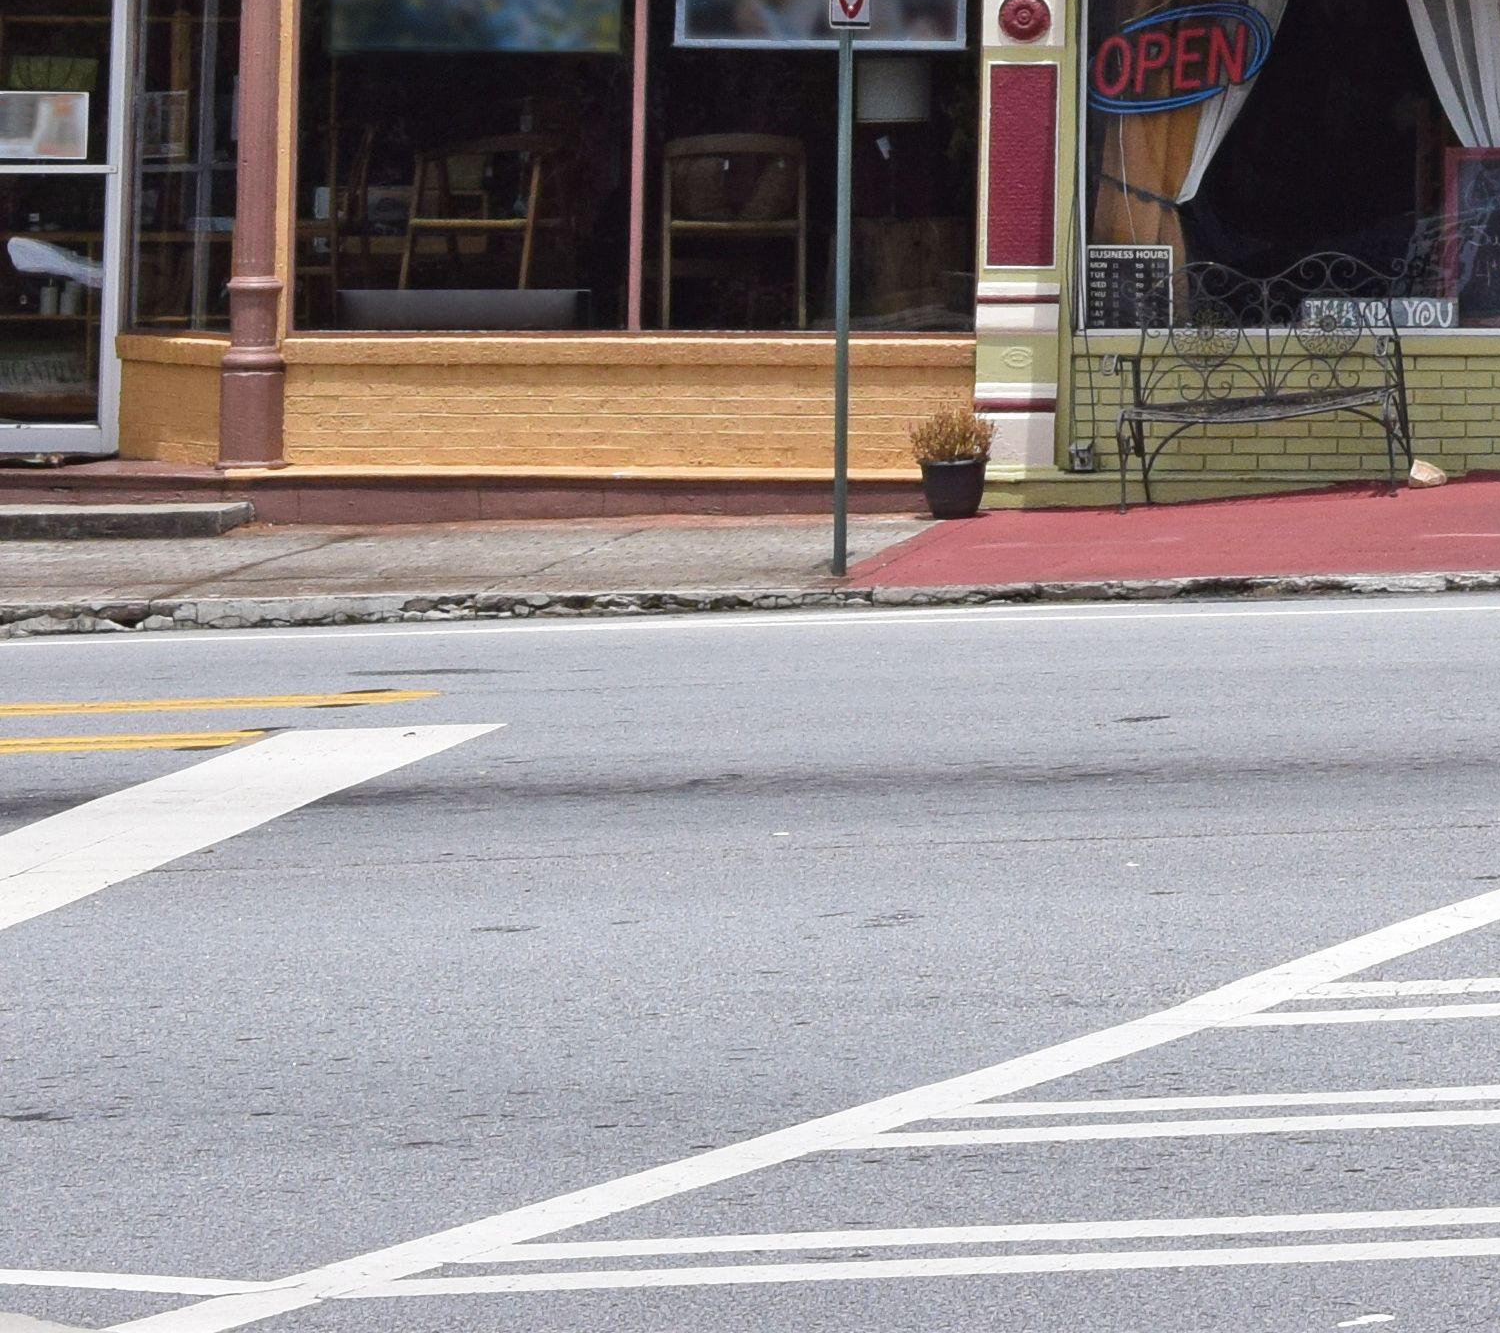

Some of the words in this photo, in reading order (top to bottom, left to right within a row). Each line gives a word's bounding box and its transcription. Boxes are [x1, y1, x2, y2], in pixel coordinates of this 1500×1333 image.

[1094, 23, 1247, 97] OPEN
[1090, 250, 1134, 259] BUSINESS
[1136, 250, 1168, 259] HOURS
[1402, 300, 1453, 328] YOU
